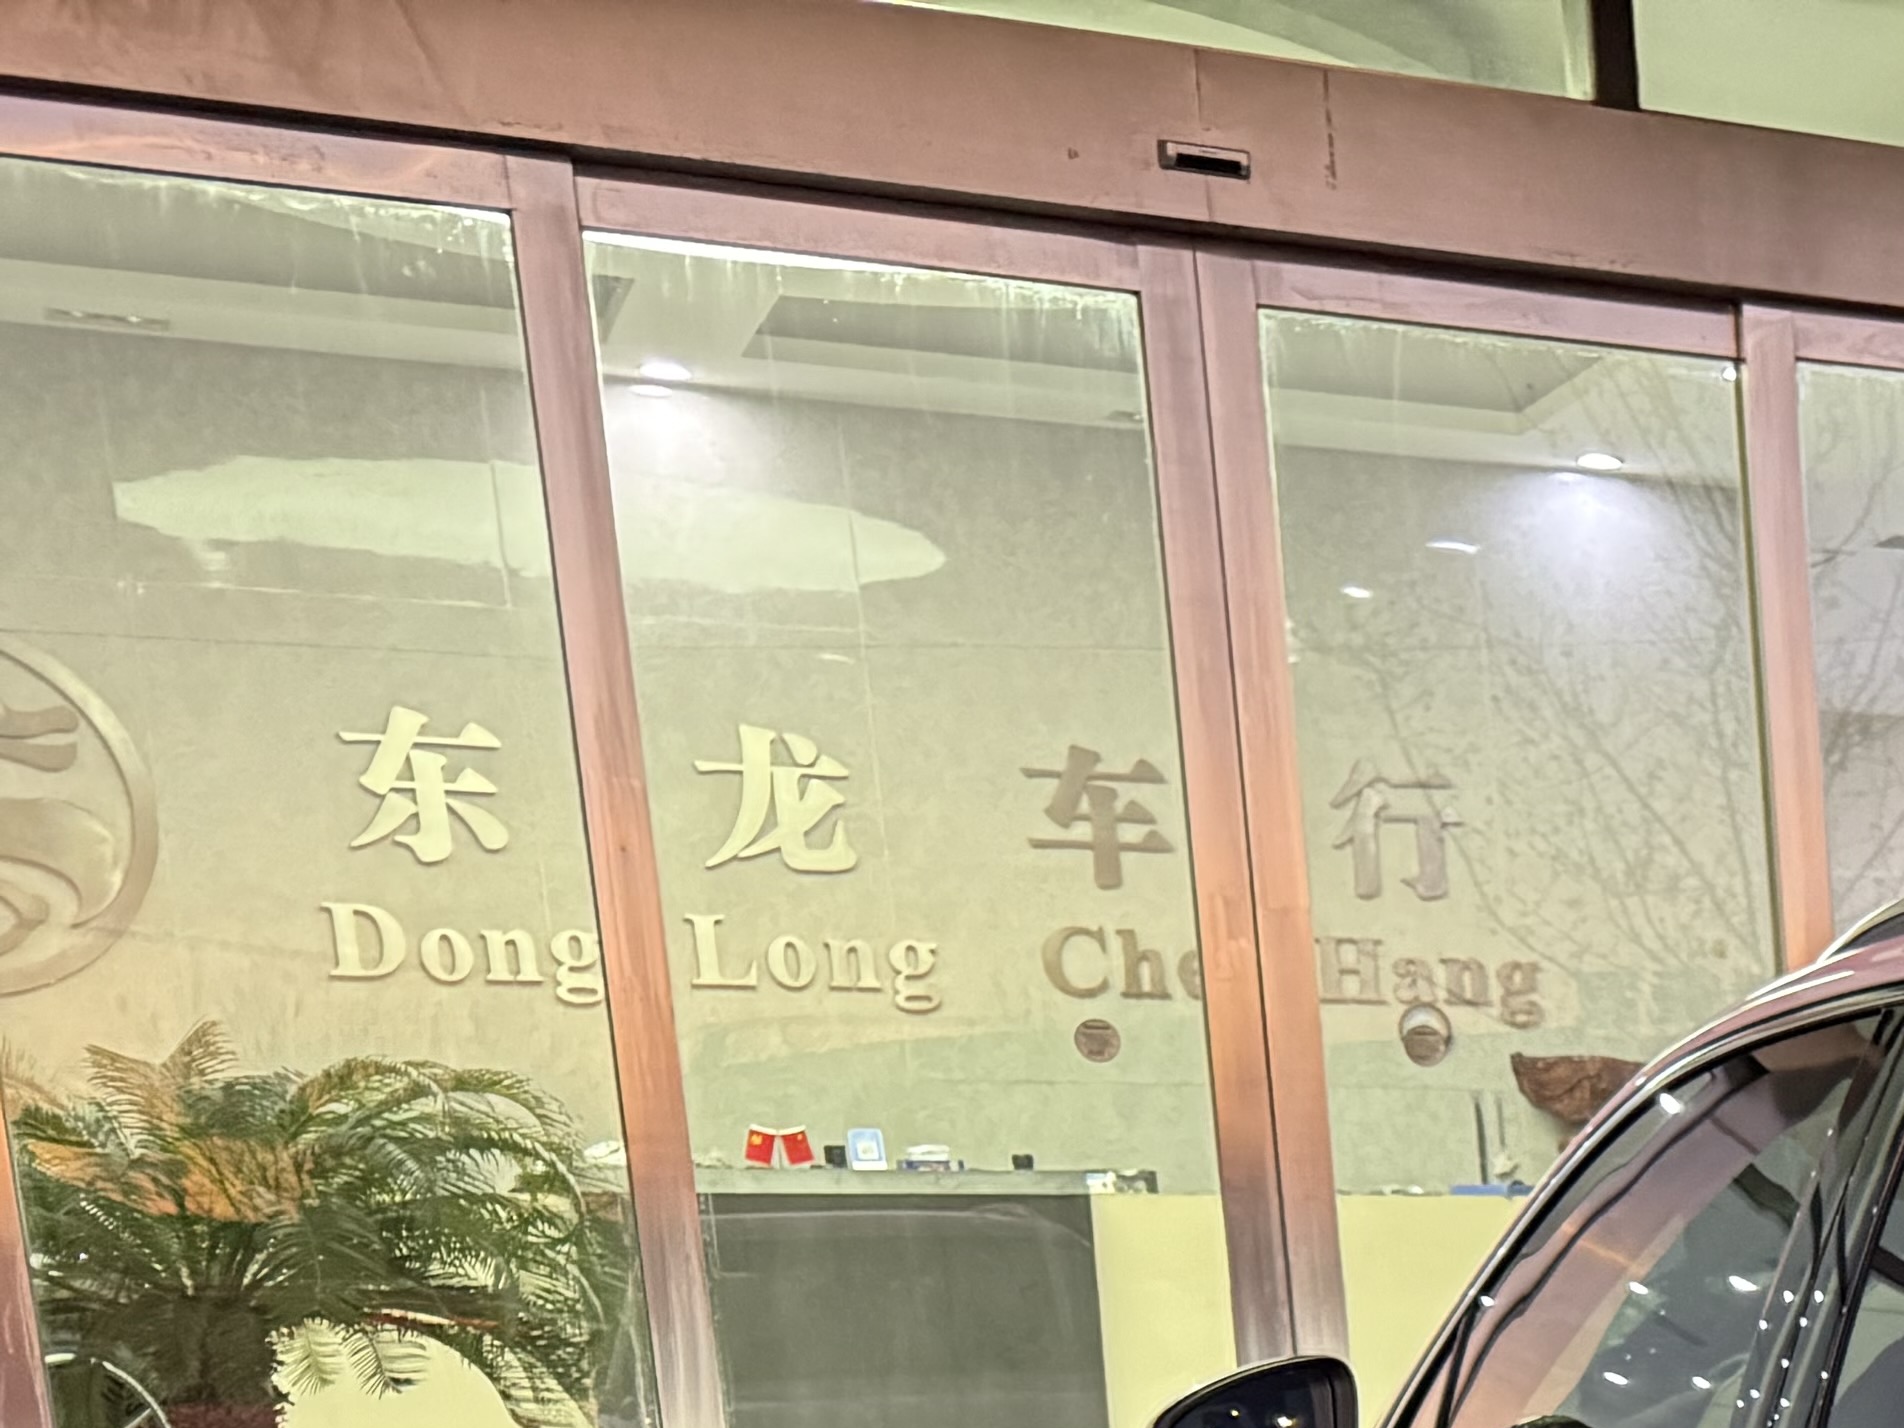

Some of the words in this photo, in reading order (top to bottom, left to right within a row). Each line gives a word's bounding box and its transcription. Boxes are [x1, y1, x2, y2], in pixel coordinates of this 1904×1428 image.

[336, 704, 1465, 901] 东龙车行
[320, 901, 605, 1005] Dong
[683, 913, 942, 1014] Long
[1314, 937, 1546, 1030] Hang
